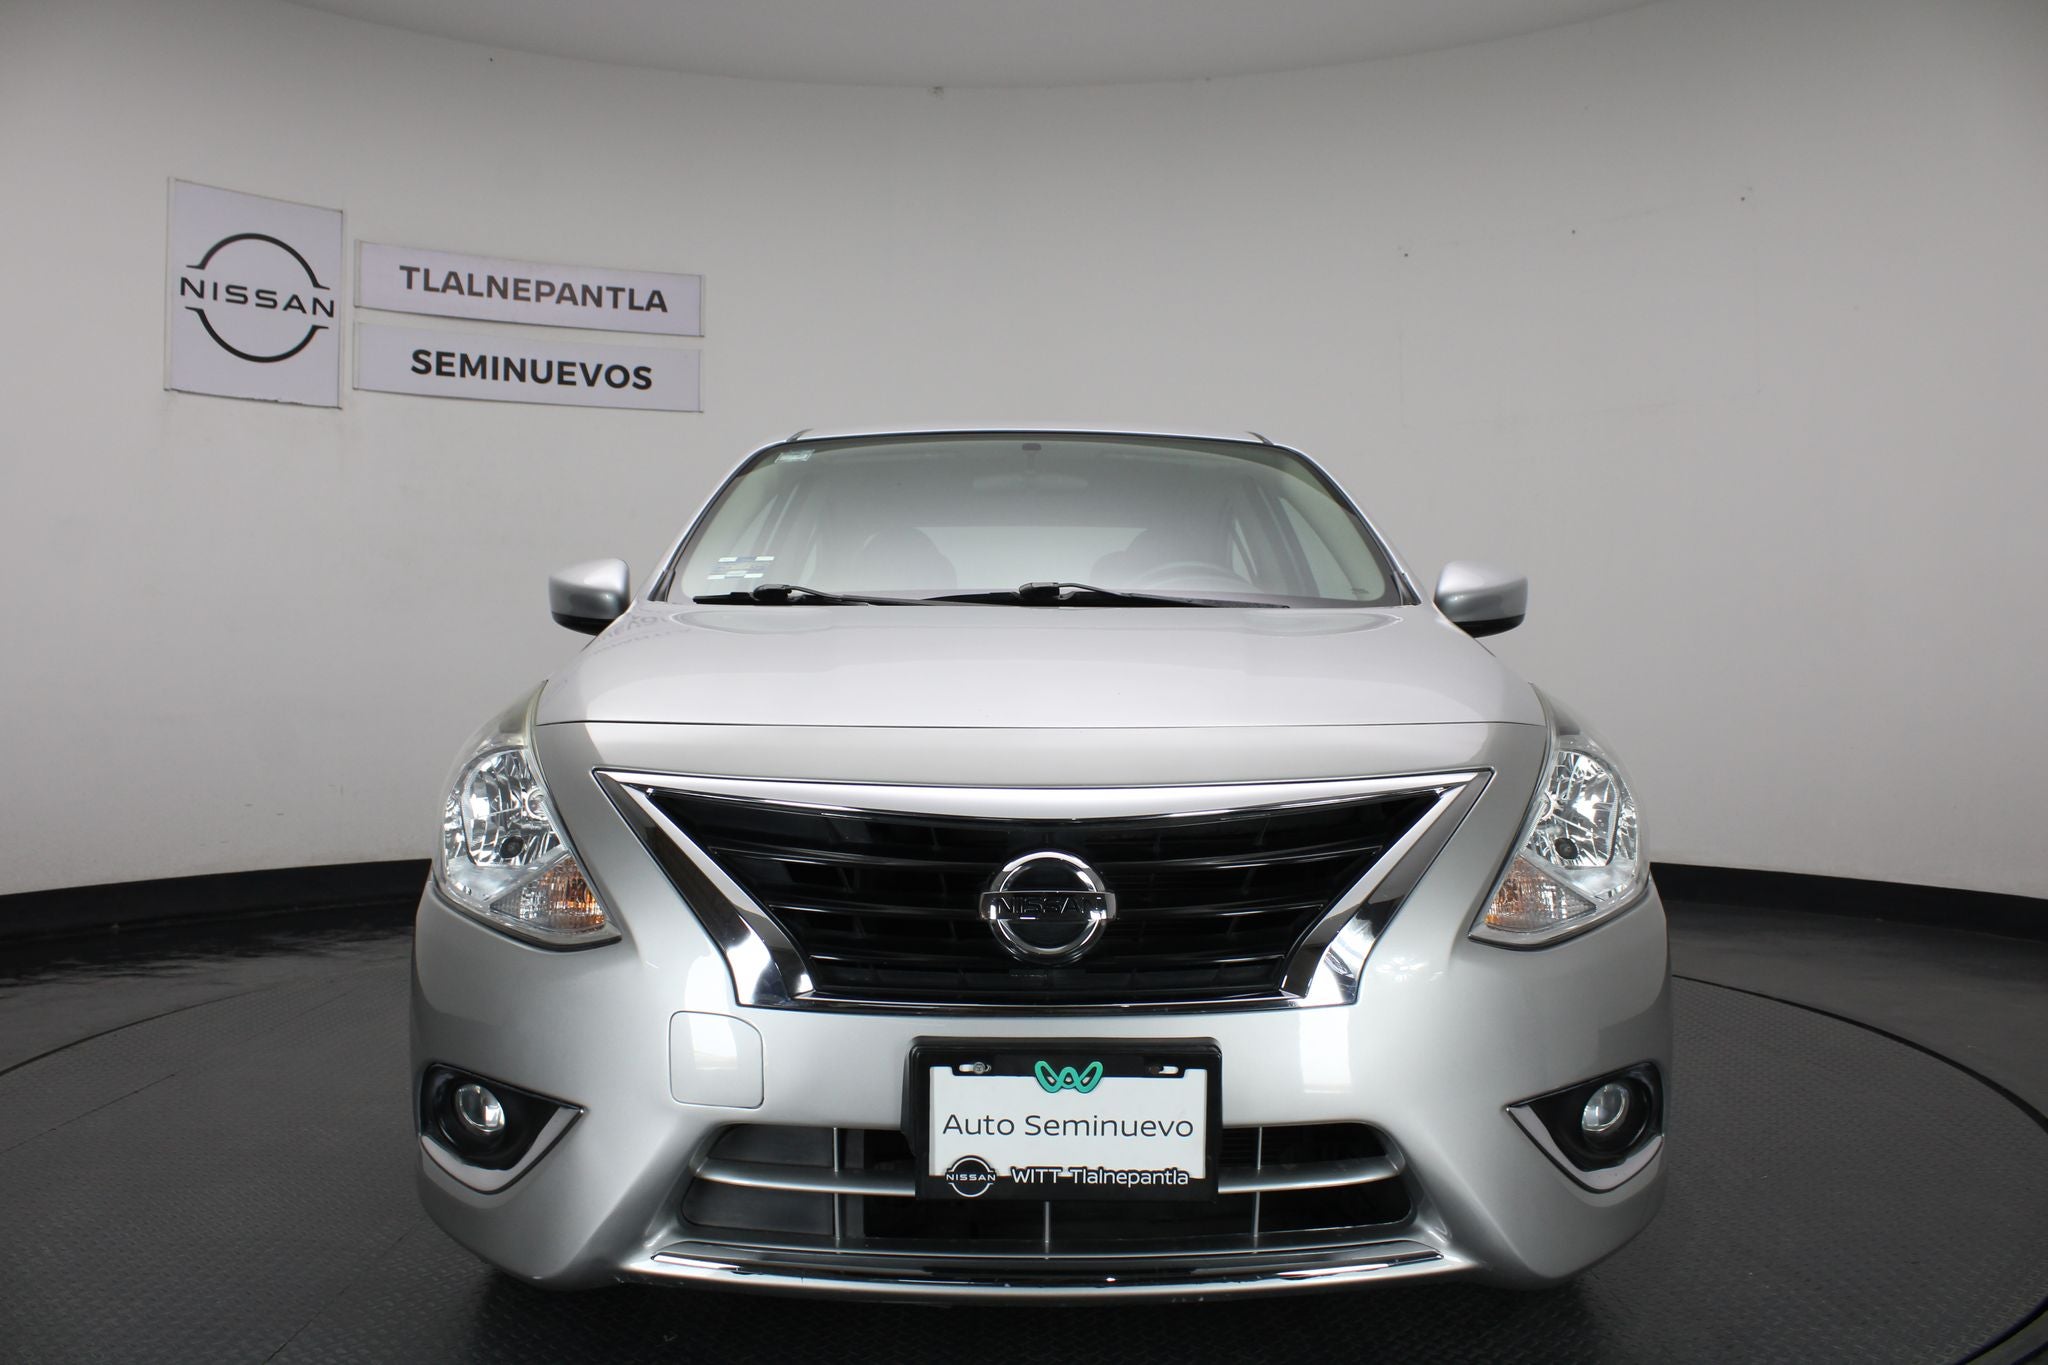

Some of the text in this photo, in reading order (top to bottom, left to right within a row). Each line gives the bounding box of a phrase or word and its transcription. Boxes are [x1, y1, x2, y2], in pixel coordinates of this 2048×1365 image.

[180, 276, 335, 319] NISSAN
[399, 264, 668, 313] TLALNEPANTLA
[411, 349, 653, 390] SEMINUEVOS
[943, 1114, 1194, 1138] Auto Seminuevo
[946, 1173, 996, 1182] NISSAN
[1011, 1168, 1189, 1188] WITT Tlalnepantla
